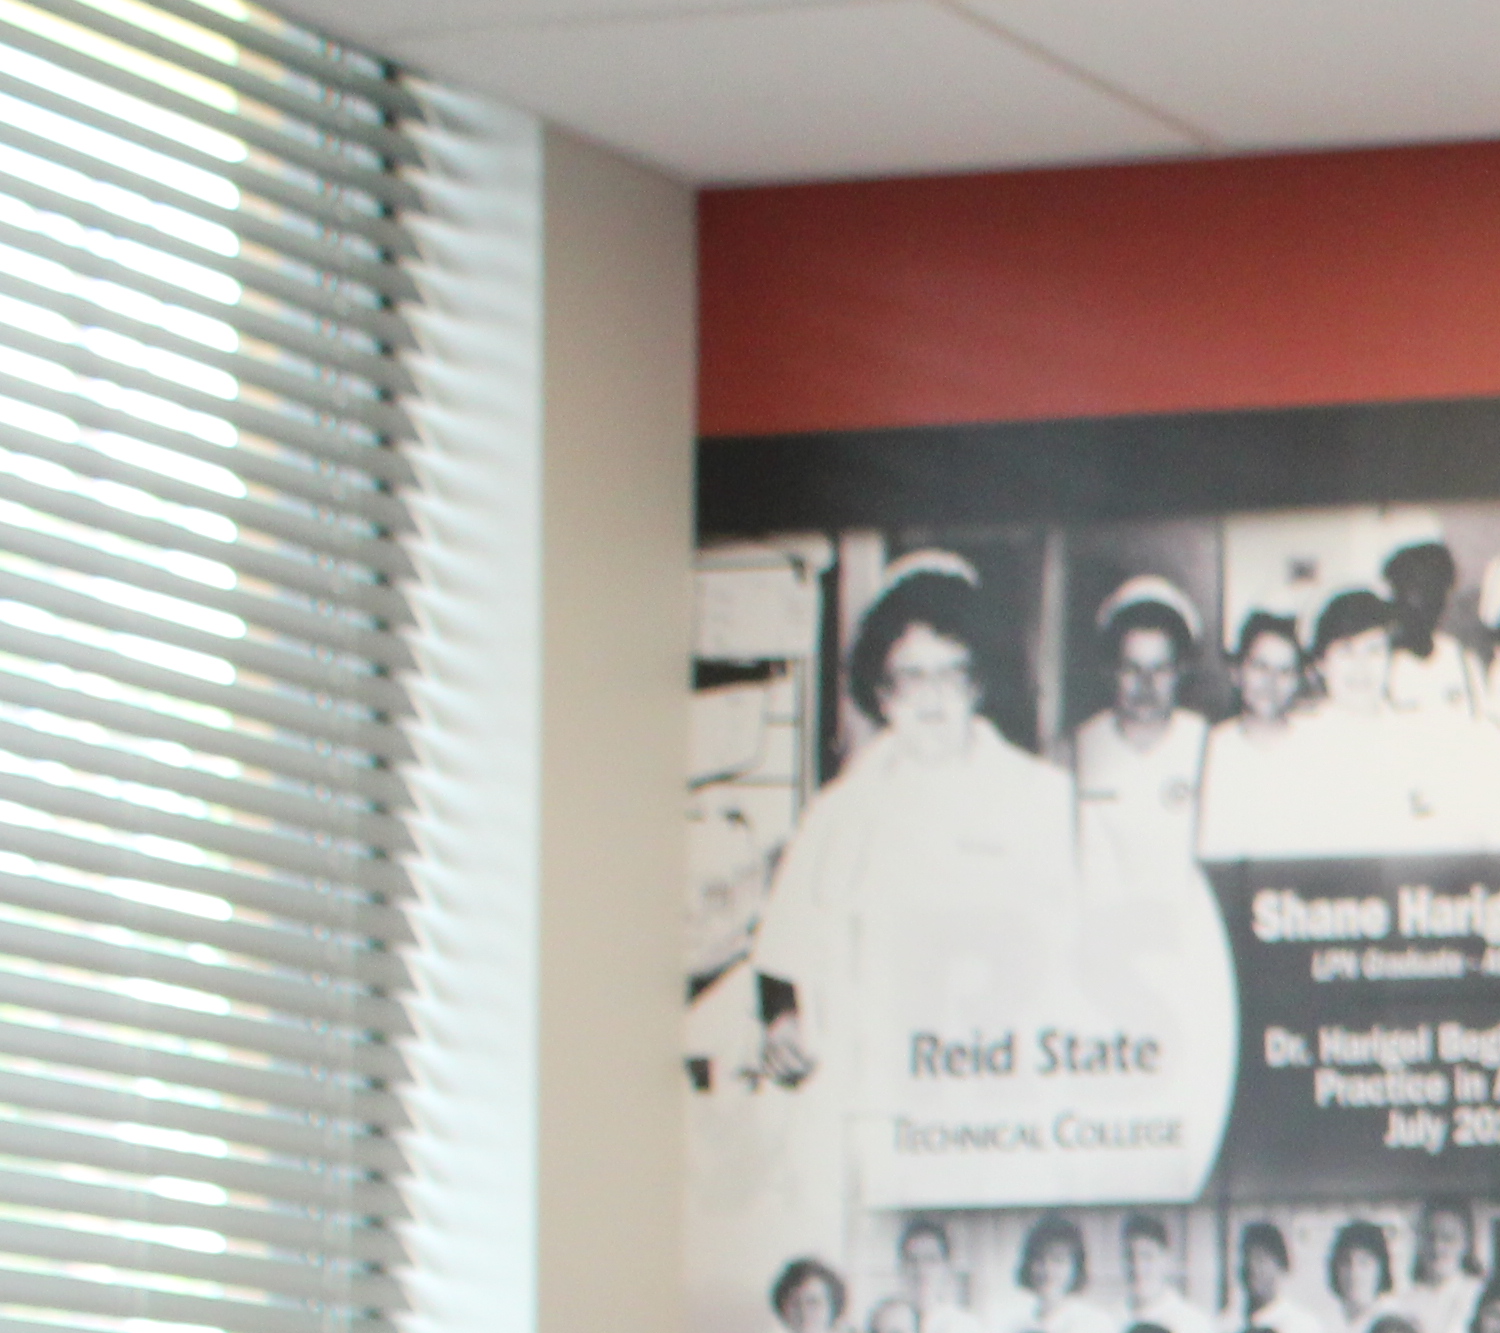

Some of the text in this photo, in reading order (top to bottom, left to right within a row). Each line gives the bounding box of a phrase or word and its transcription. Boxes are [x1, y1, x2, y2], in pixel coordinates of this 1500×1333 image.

[1252, 887, 1391, 942] Shane
[909, 1025, 1162, 1077] Reid State
[1263, 1024, 1314, 1068] Dr.
[1318, 1022, 1433, 1072] Harigel
[1314, 1067, 1449, 1108] Practice
[1454, 1064, 1489, 1104] in
[893, 1110, 1184, 1153] TECHNICAL COLLEGE
[1384, 1108, 1447, 1156] July
